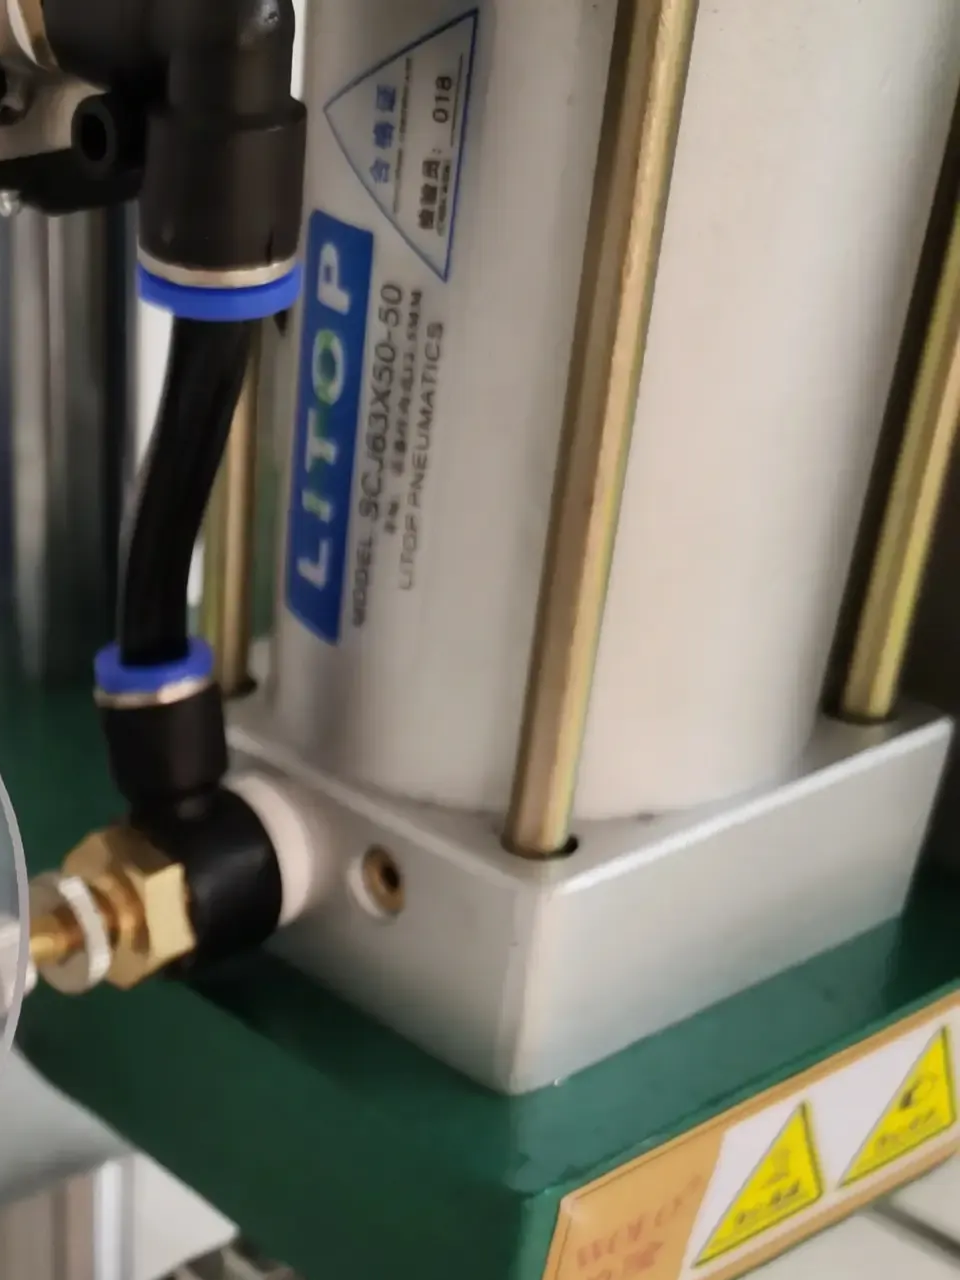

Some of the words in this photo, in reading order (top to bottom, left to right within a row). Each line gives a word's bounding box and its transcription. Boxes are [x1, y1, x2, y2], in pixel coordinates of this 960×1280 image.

[432, 75, 453, 124] 018
[297, 241, 350, 592] LITOP
[407, 321, 444, 509] PNEUMATICS
